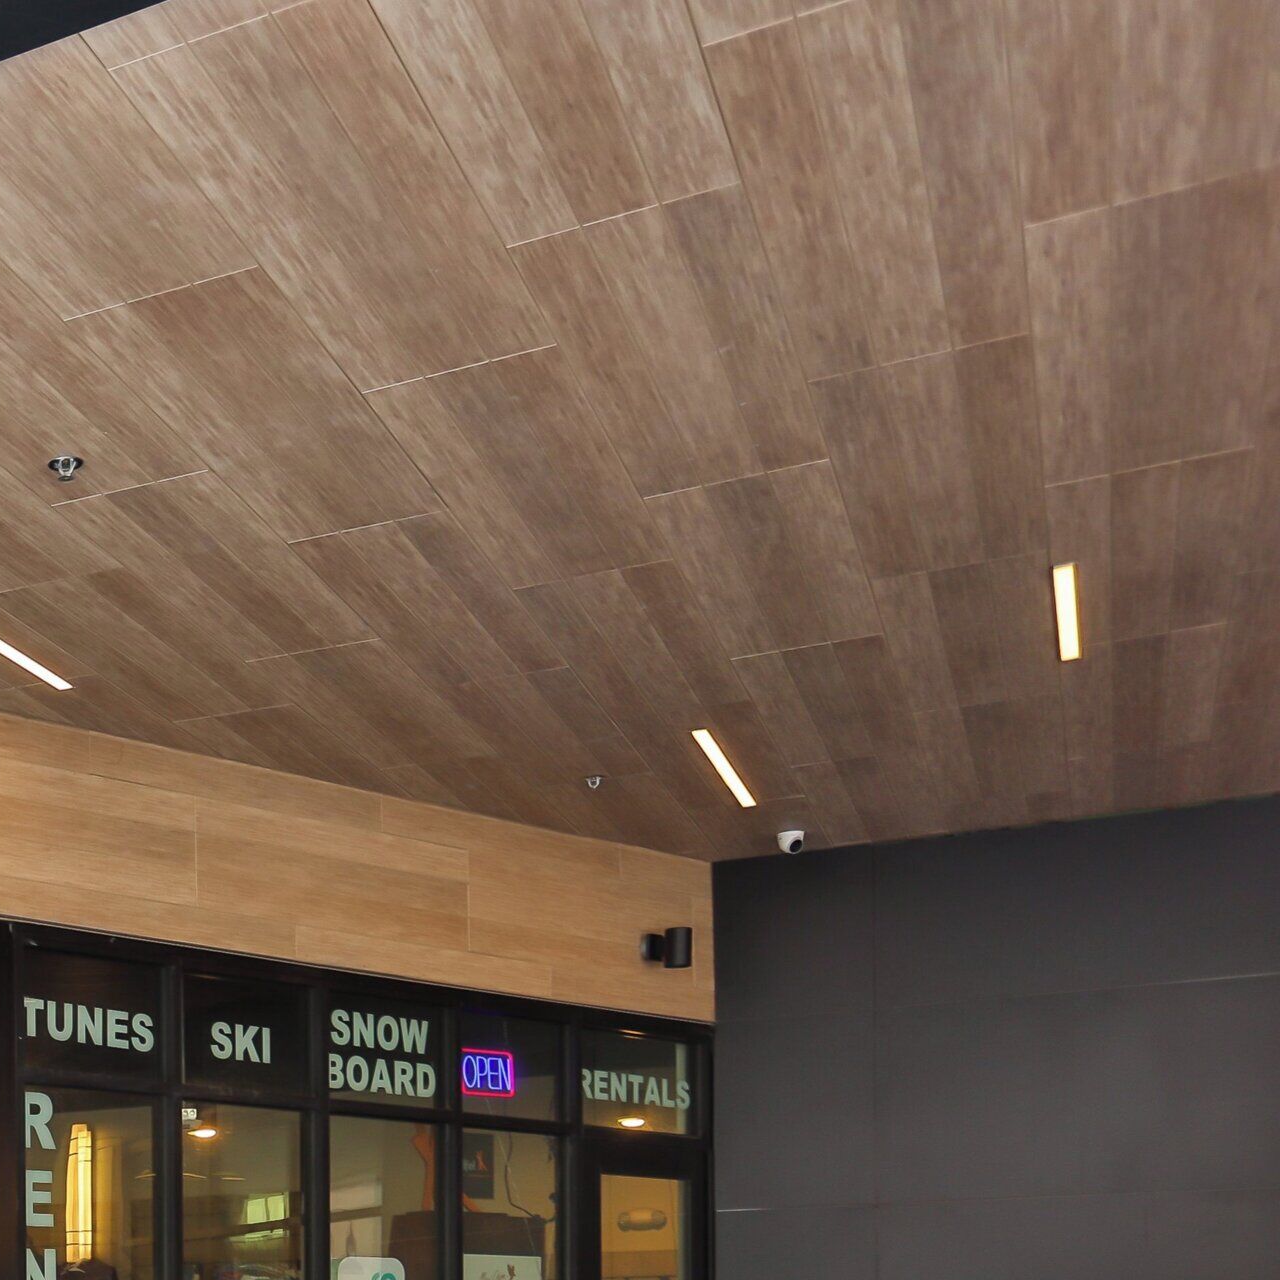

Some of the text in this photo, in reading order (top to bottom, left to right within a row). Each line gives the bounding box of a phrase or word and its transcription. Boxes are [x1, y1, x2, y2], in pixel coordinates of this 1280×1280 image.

[23, 995, 155, 1053] TUNES
[209, 1021, 271, 1065] SKI
[329, 1008, 429, 1055] SNOW
[328, 1053, 437, 1099] BOARD
[462, 1054, 512, 1092] OPEN
[581, 1067, 691, 1111] RENTALS
